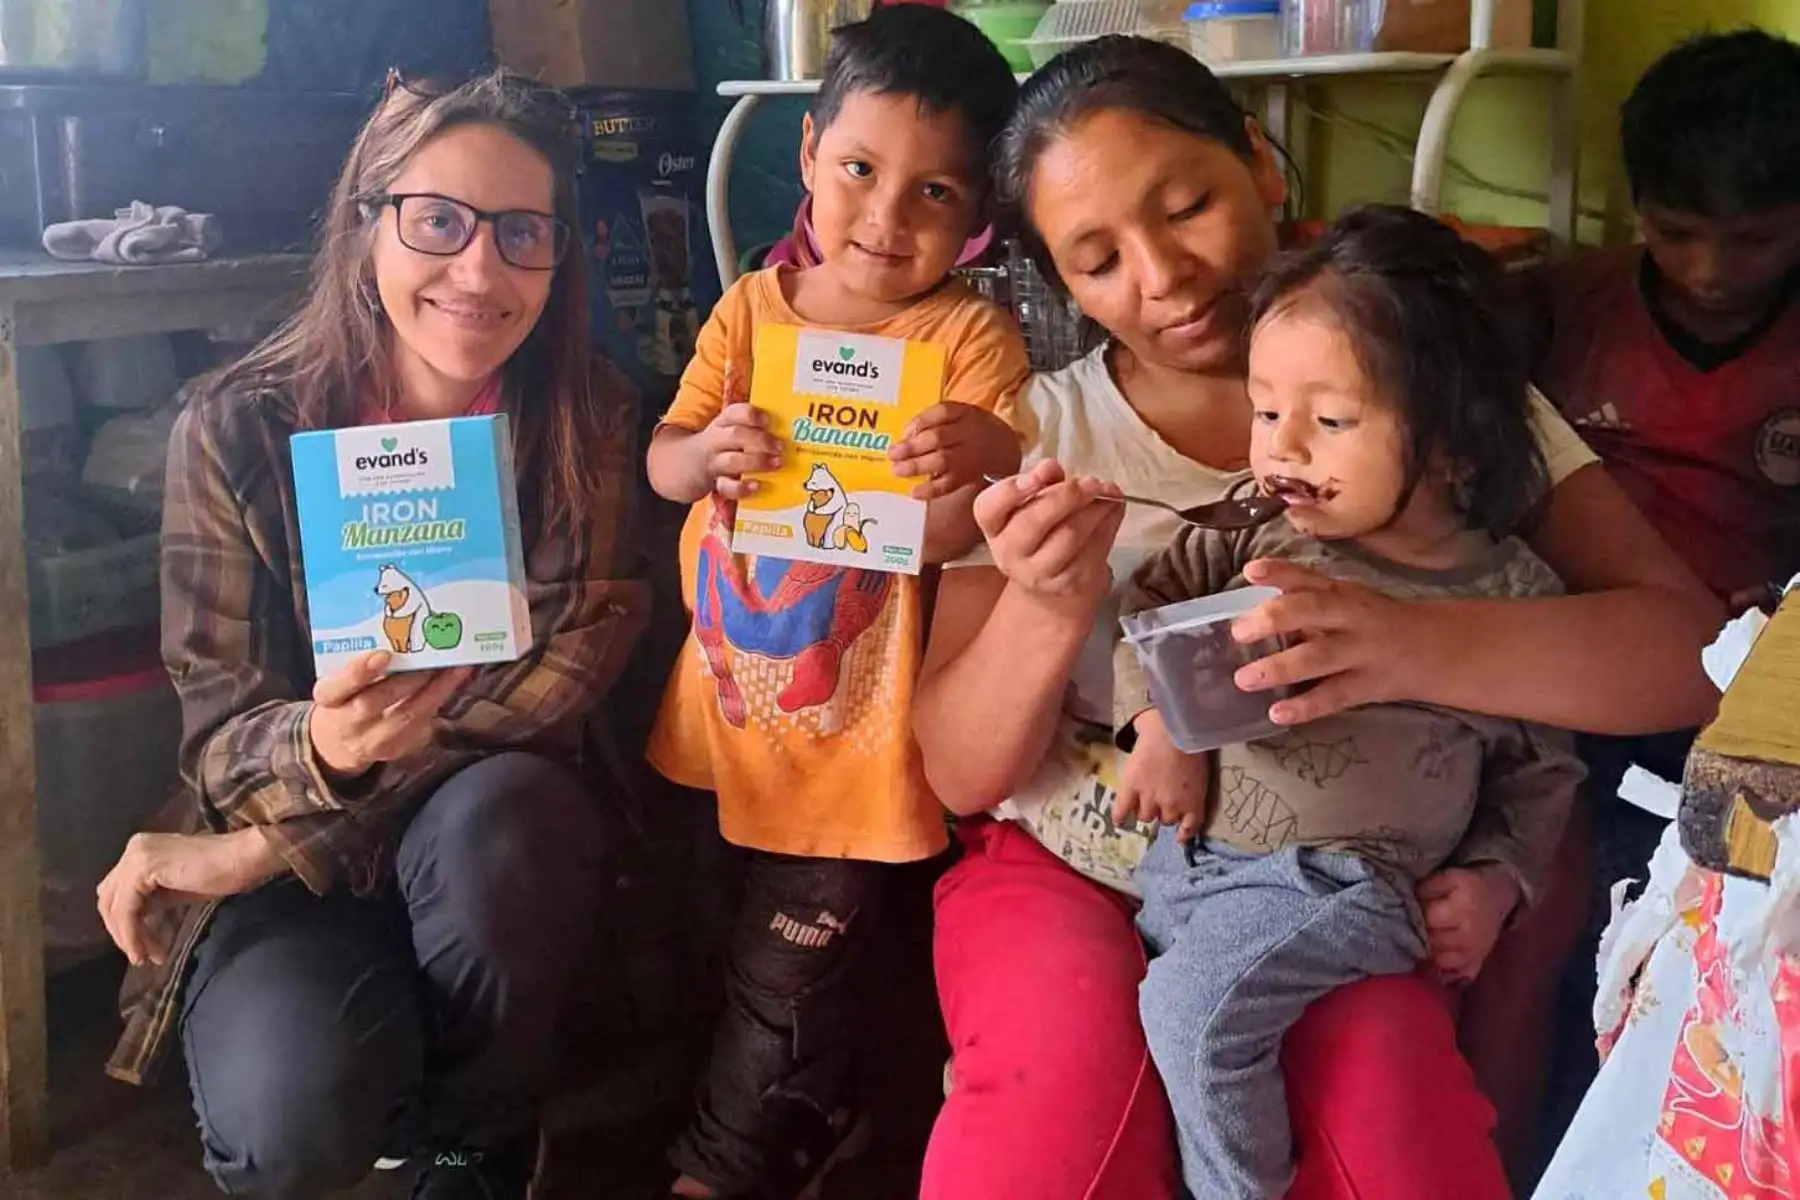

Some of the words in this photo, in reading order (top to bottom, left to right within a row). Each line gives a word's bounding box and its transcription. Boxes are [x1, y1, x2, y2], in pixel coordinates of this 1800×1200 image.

[658, 152, 695, 178] Oster
[812, 358, 880, 379] evand's
[808, 402, 880, 430] IRON
[793, 417, 891, 451] Banana
[355, 447, 428, 470] evand's
[362, 498, 438, 524] IRON
[341, 518, 466, 550] Manzana
[322, 637, 372, 654] Papilla
